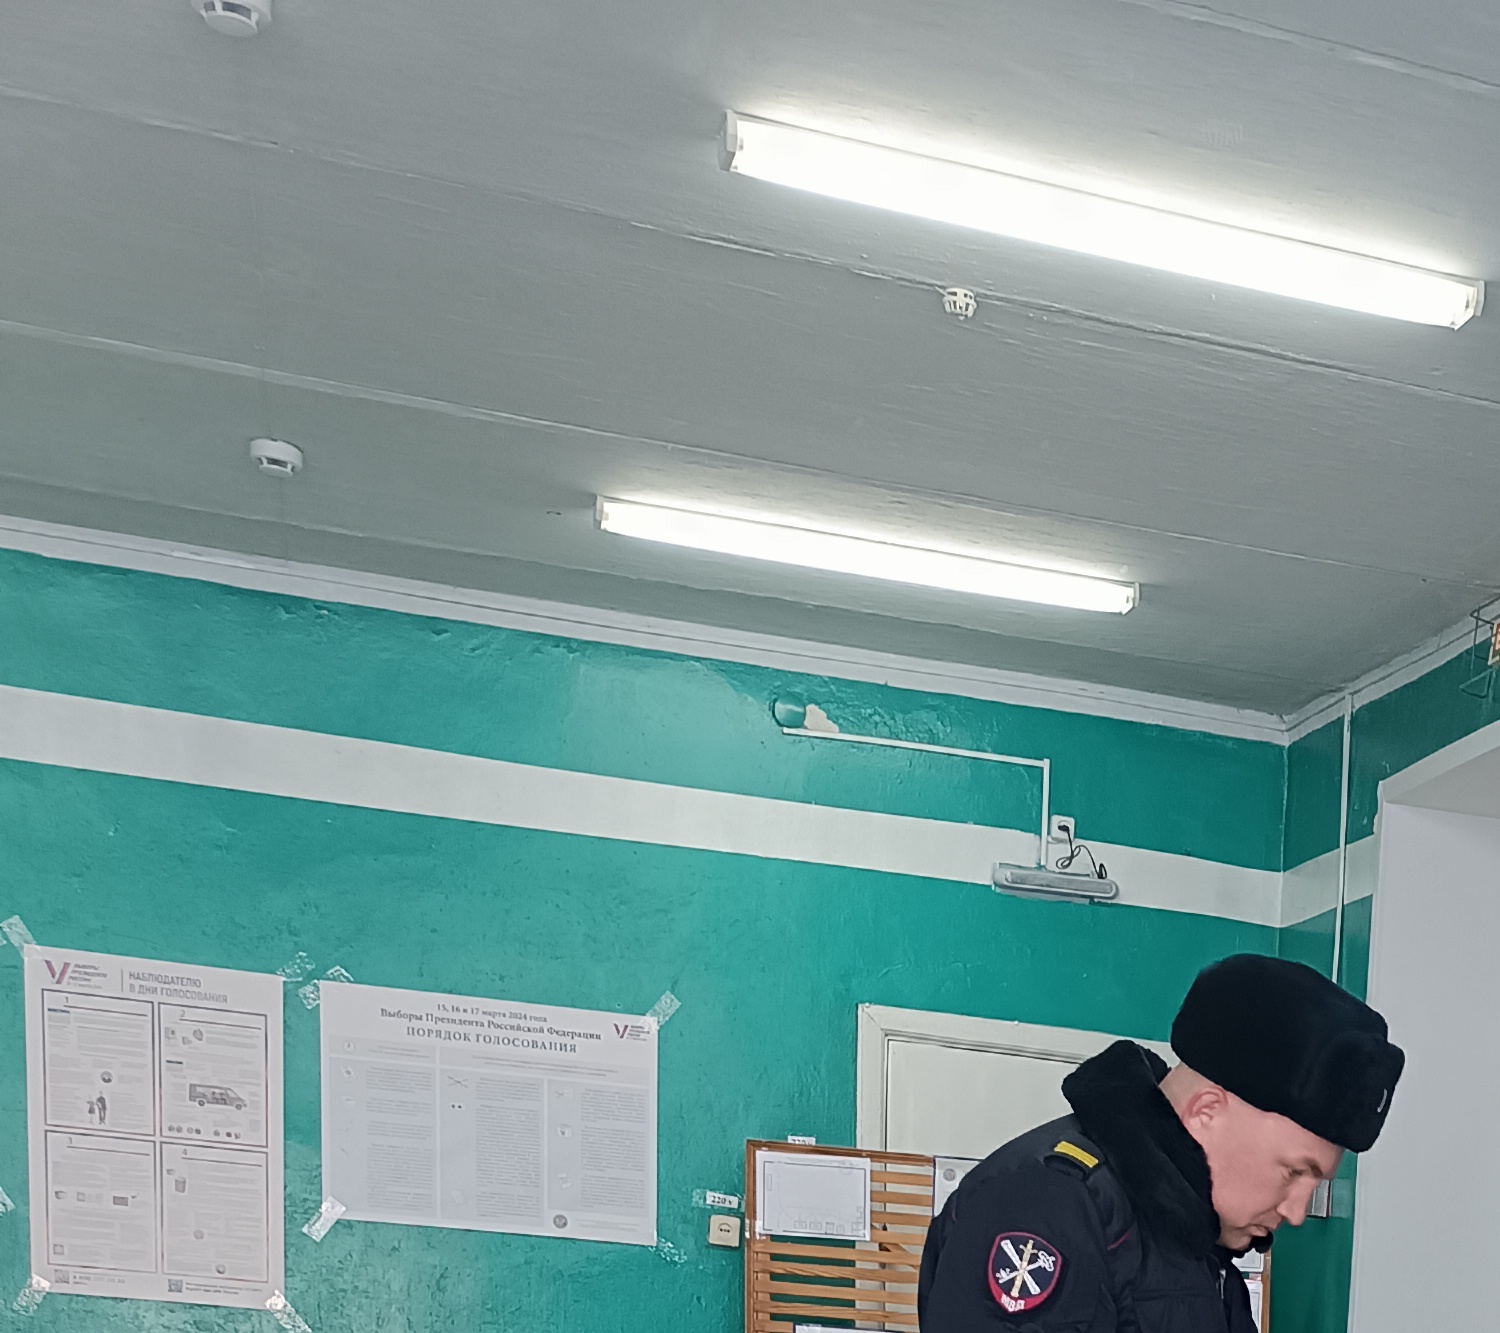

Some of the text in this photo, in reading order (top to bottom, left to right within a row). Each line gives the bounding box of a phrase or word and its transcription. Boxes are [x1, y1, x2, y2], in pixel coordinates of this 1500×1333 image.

[128, 971, 202, 988] НАБЛЮДАТЕЛЮ
[137, 985, 158, 997] ДНИ
[160, 987, 228, 1003] ГОЛОСОВАНИЯ
[380, 1008, 602, 1041] Выборы Президента Российской Федерации
[406, 1026, 577, 1053] ПОРЯДОК ГОЛОСОВАНИЯ
[711, 1195, 726, 1204] 220
[1001, 1293, 1025, 1312] МВД
